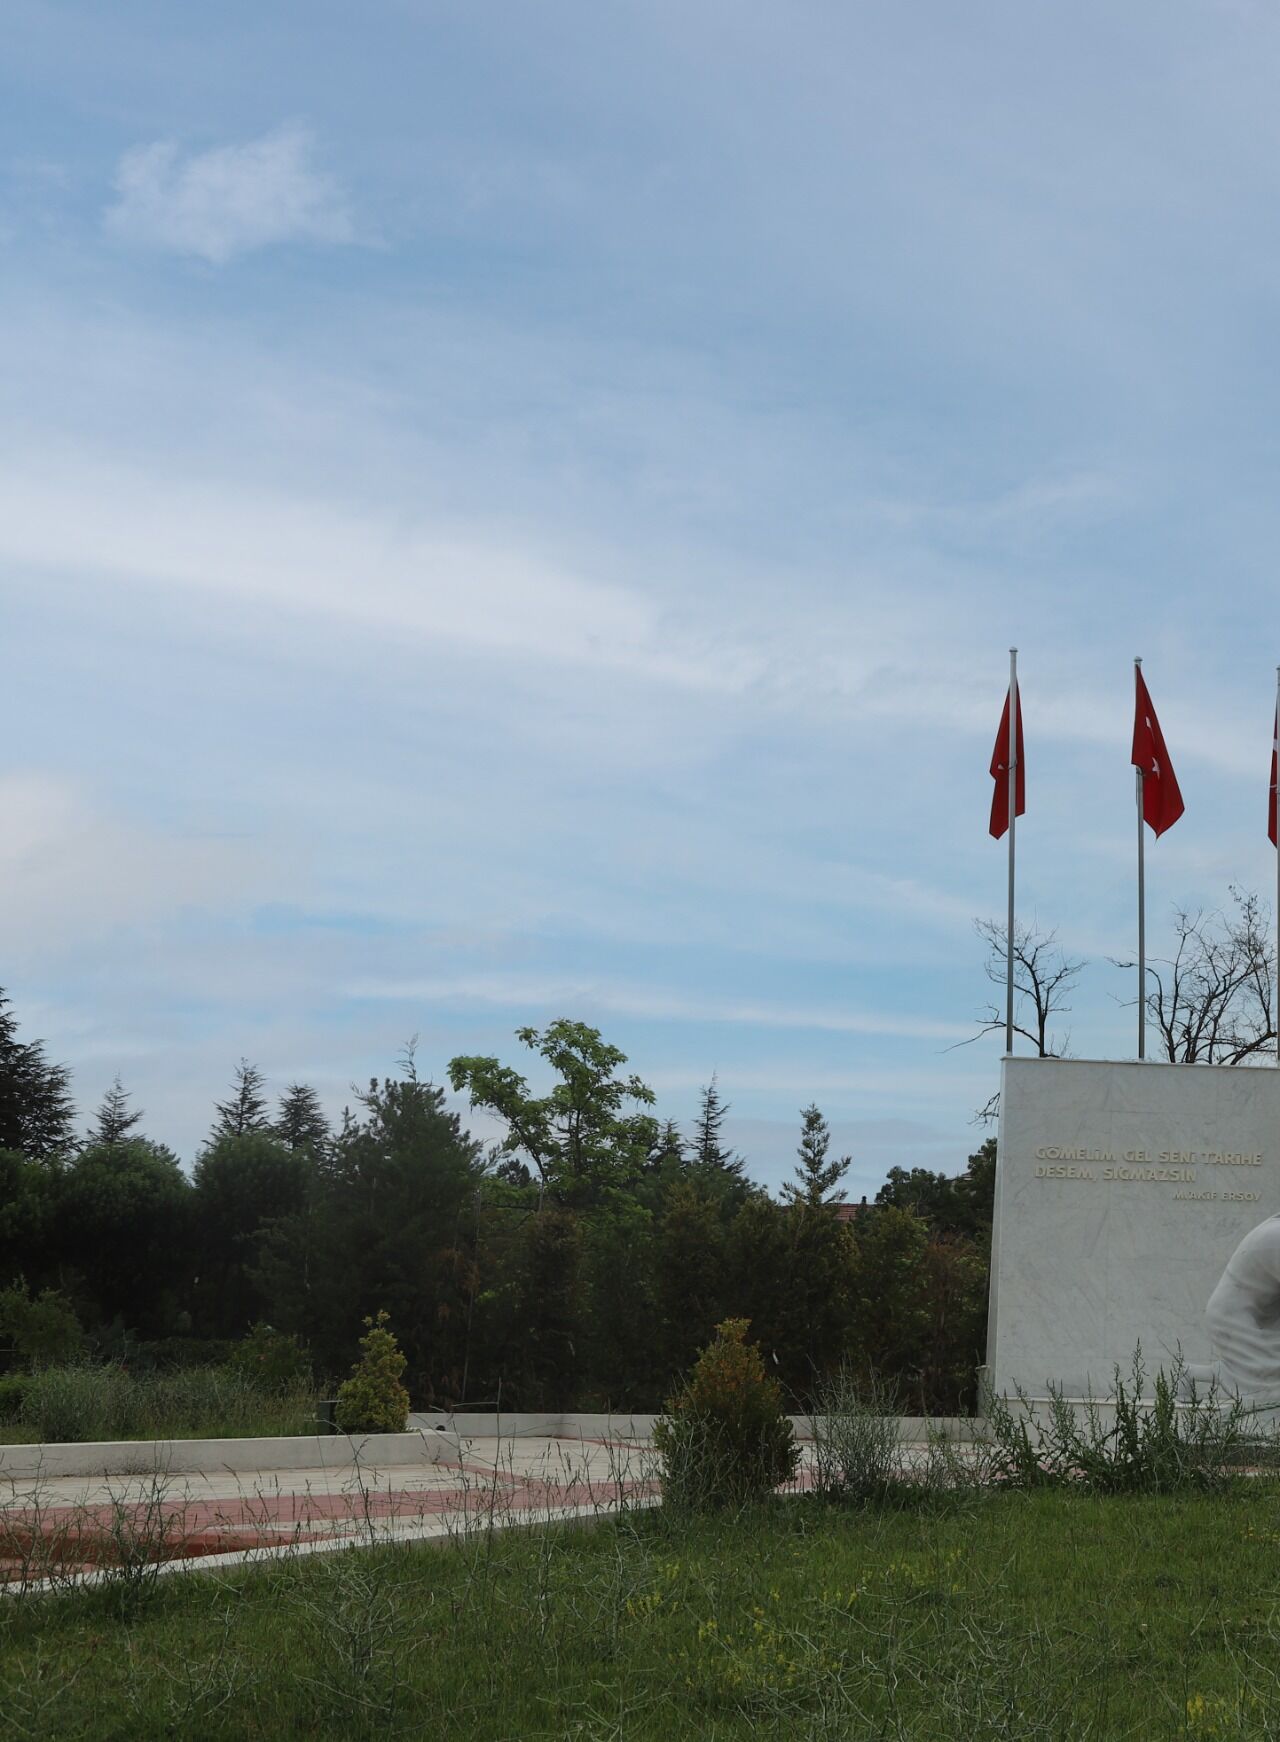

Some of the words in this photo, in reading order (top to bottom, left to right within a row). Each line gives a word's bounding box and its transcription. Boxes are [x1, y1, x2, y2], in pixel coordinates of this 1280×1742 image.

[1123, 1150, 1152, 1162] GEL
[1201, 1152, 1263, 1166] TARİHE
[1222, 1192, 1262, 1202] ERSOY
